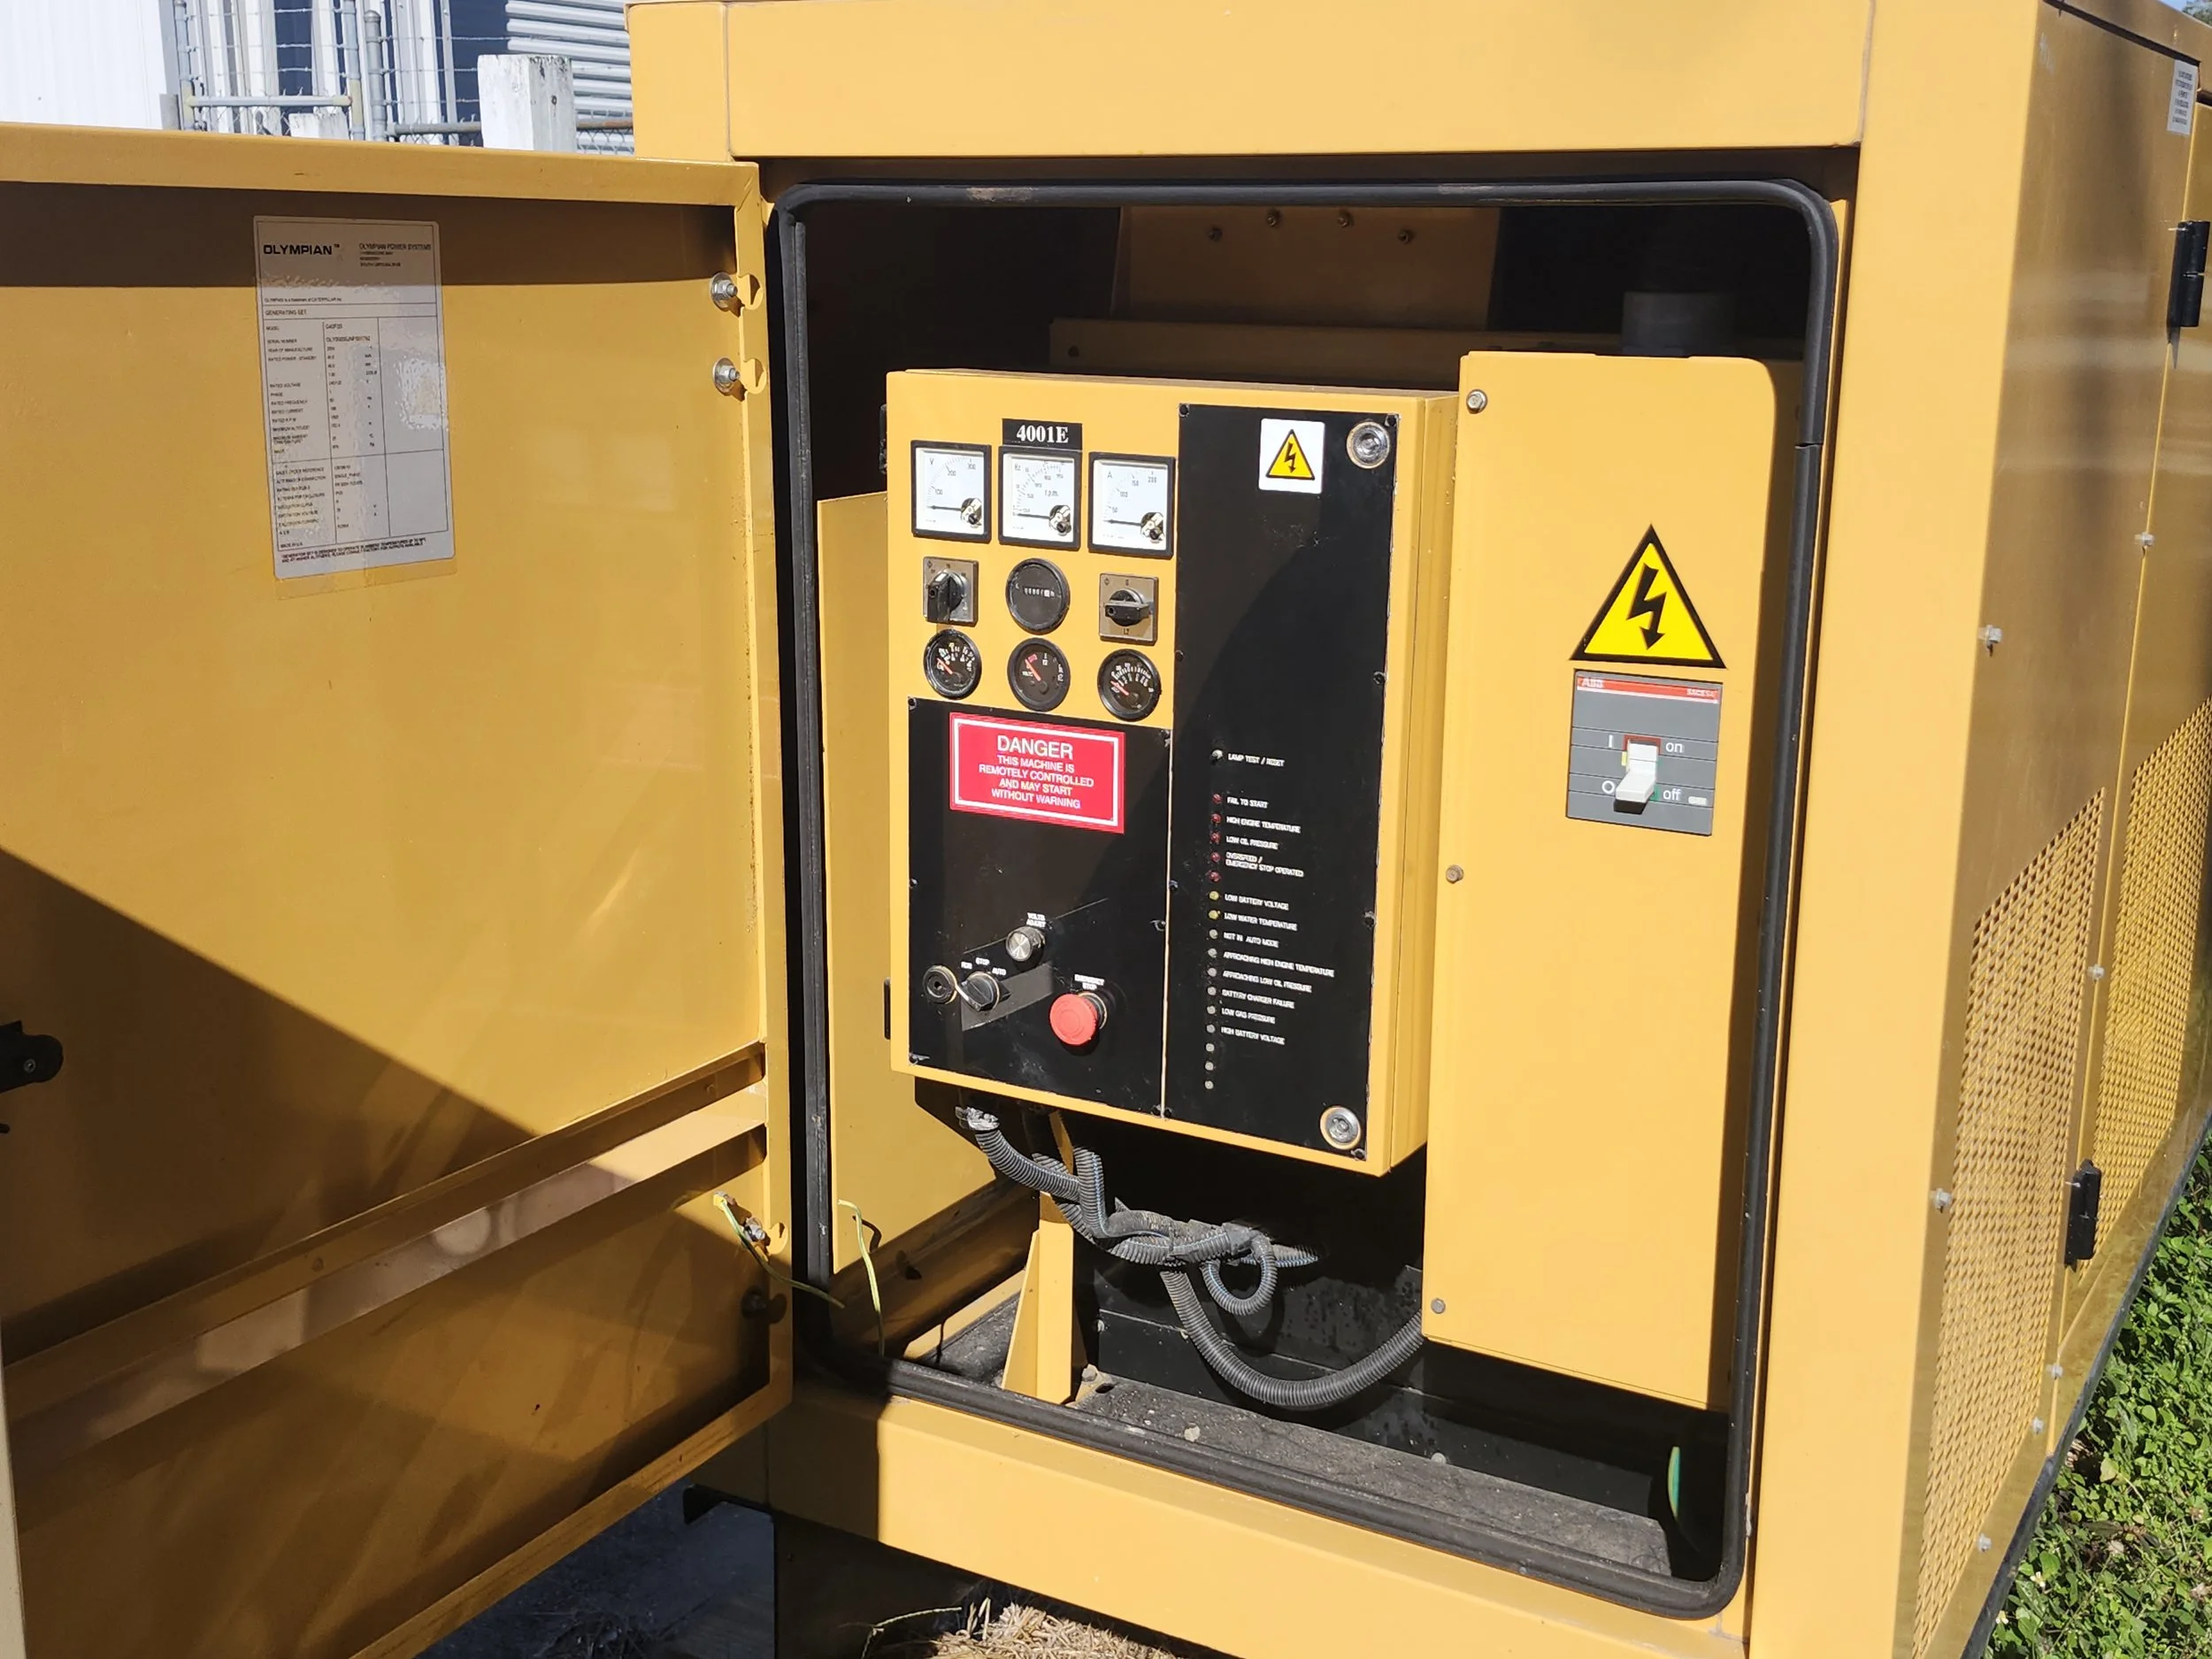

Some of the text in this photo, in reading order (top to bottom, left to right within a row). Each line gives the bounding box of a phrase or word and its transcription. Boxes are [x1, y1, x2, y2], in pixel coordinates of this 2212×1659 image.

[263, 244, 332, 256] OLYMPIAN
[1017, 425, 1069, 443] 4001E
[1582, 677, 1604, 688] ABB
[997, 735, 1073, 760] DANGER
[1665, 741, 1683, 753] on
[997, 754, 1075, 773] THIS MACHINE IS
[1228, 753, 1244, 762] LAMP
[1245, 755, 1260, 764] TEST
[1266, 758, 1285, 767] RESET
[979, 764, 1094, 787] REMOTELY CONTROLLED
[999, 778, 1072, 795] AND MAY START
[1663, 787, 1681, 801] off
[991, 788, 1081, 810] WITHOUT WARNING
[1226, 796, 1240, 805] FAIL
[1249, 799, 1268, 809] START
[1240, 818, 1260, 828] ENGINE
[1261, 820, 1301, 833] TEMPERATURE
[1240, 837, 1249, 846] OIL
[1249, 839, 1279, 849] PRESSURE
[1225, 859, 1304, 878] EMERGENCY STOP OPERATED
[1225, 894, 1289, 910] LOW BATTERY VOLTAGE
[1224, 912, 1297, 931] LOW WATER TEMPERATURE
[1224, 932, 1235, 941] NOT
[1246, 936, 1262, 945] AUTO
[1262, 939, 1279, 948] MODE
[1223, 951, 1334, 978] APPROACHING HIGH ENGINE TEMPERATURE
[1222, 971, 1312, 993] APPROACHING LOW OIL PRESSURE
[1222, 989, 1295, 1009] BATTERY CHARGER FAILURE
[1221, 1007, 1276, 1024] LOW GAS PRESSURE
[1221, 1026, 1285, 1045] HIGH BATTERY VOLTAGE
